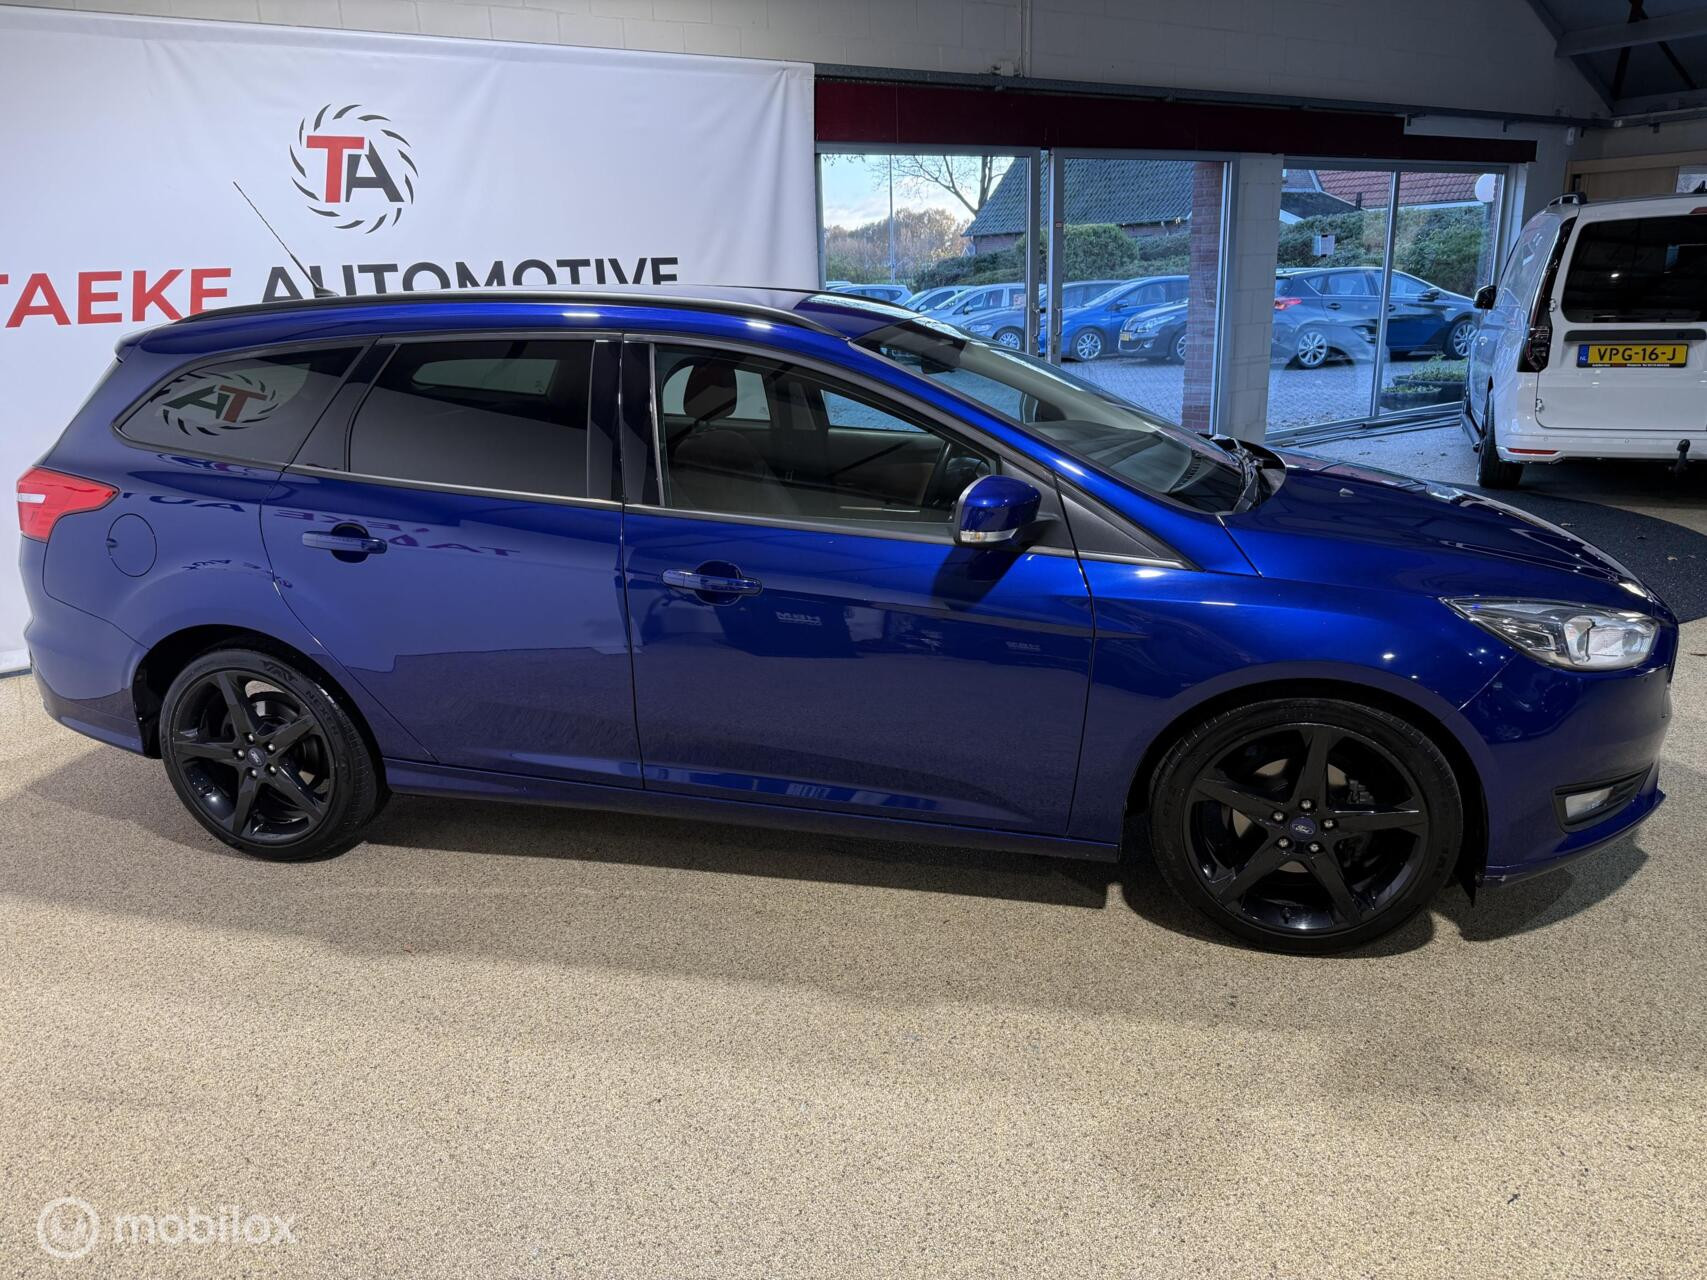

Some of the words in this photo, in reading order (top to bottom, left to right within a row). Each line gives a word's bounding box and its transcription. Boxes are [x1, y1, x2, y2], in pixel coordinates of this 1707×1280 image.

[306, 135, 405, 203] TA
[0, 268, 232, 328] AEKE
[1598, 347, 1676, 361] VPG-16-J
